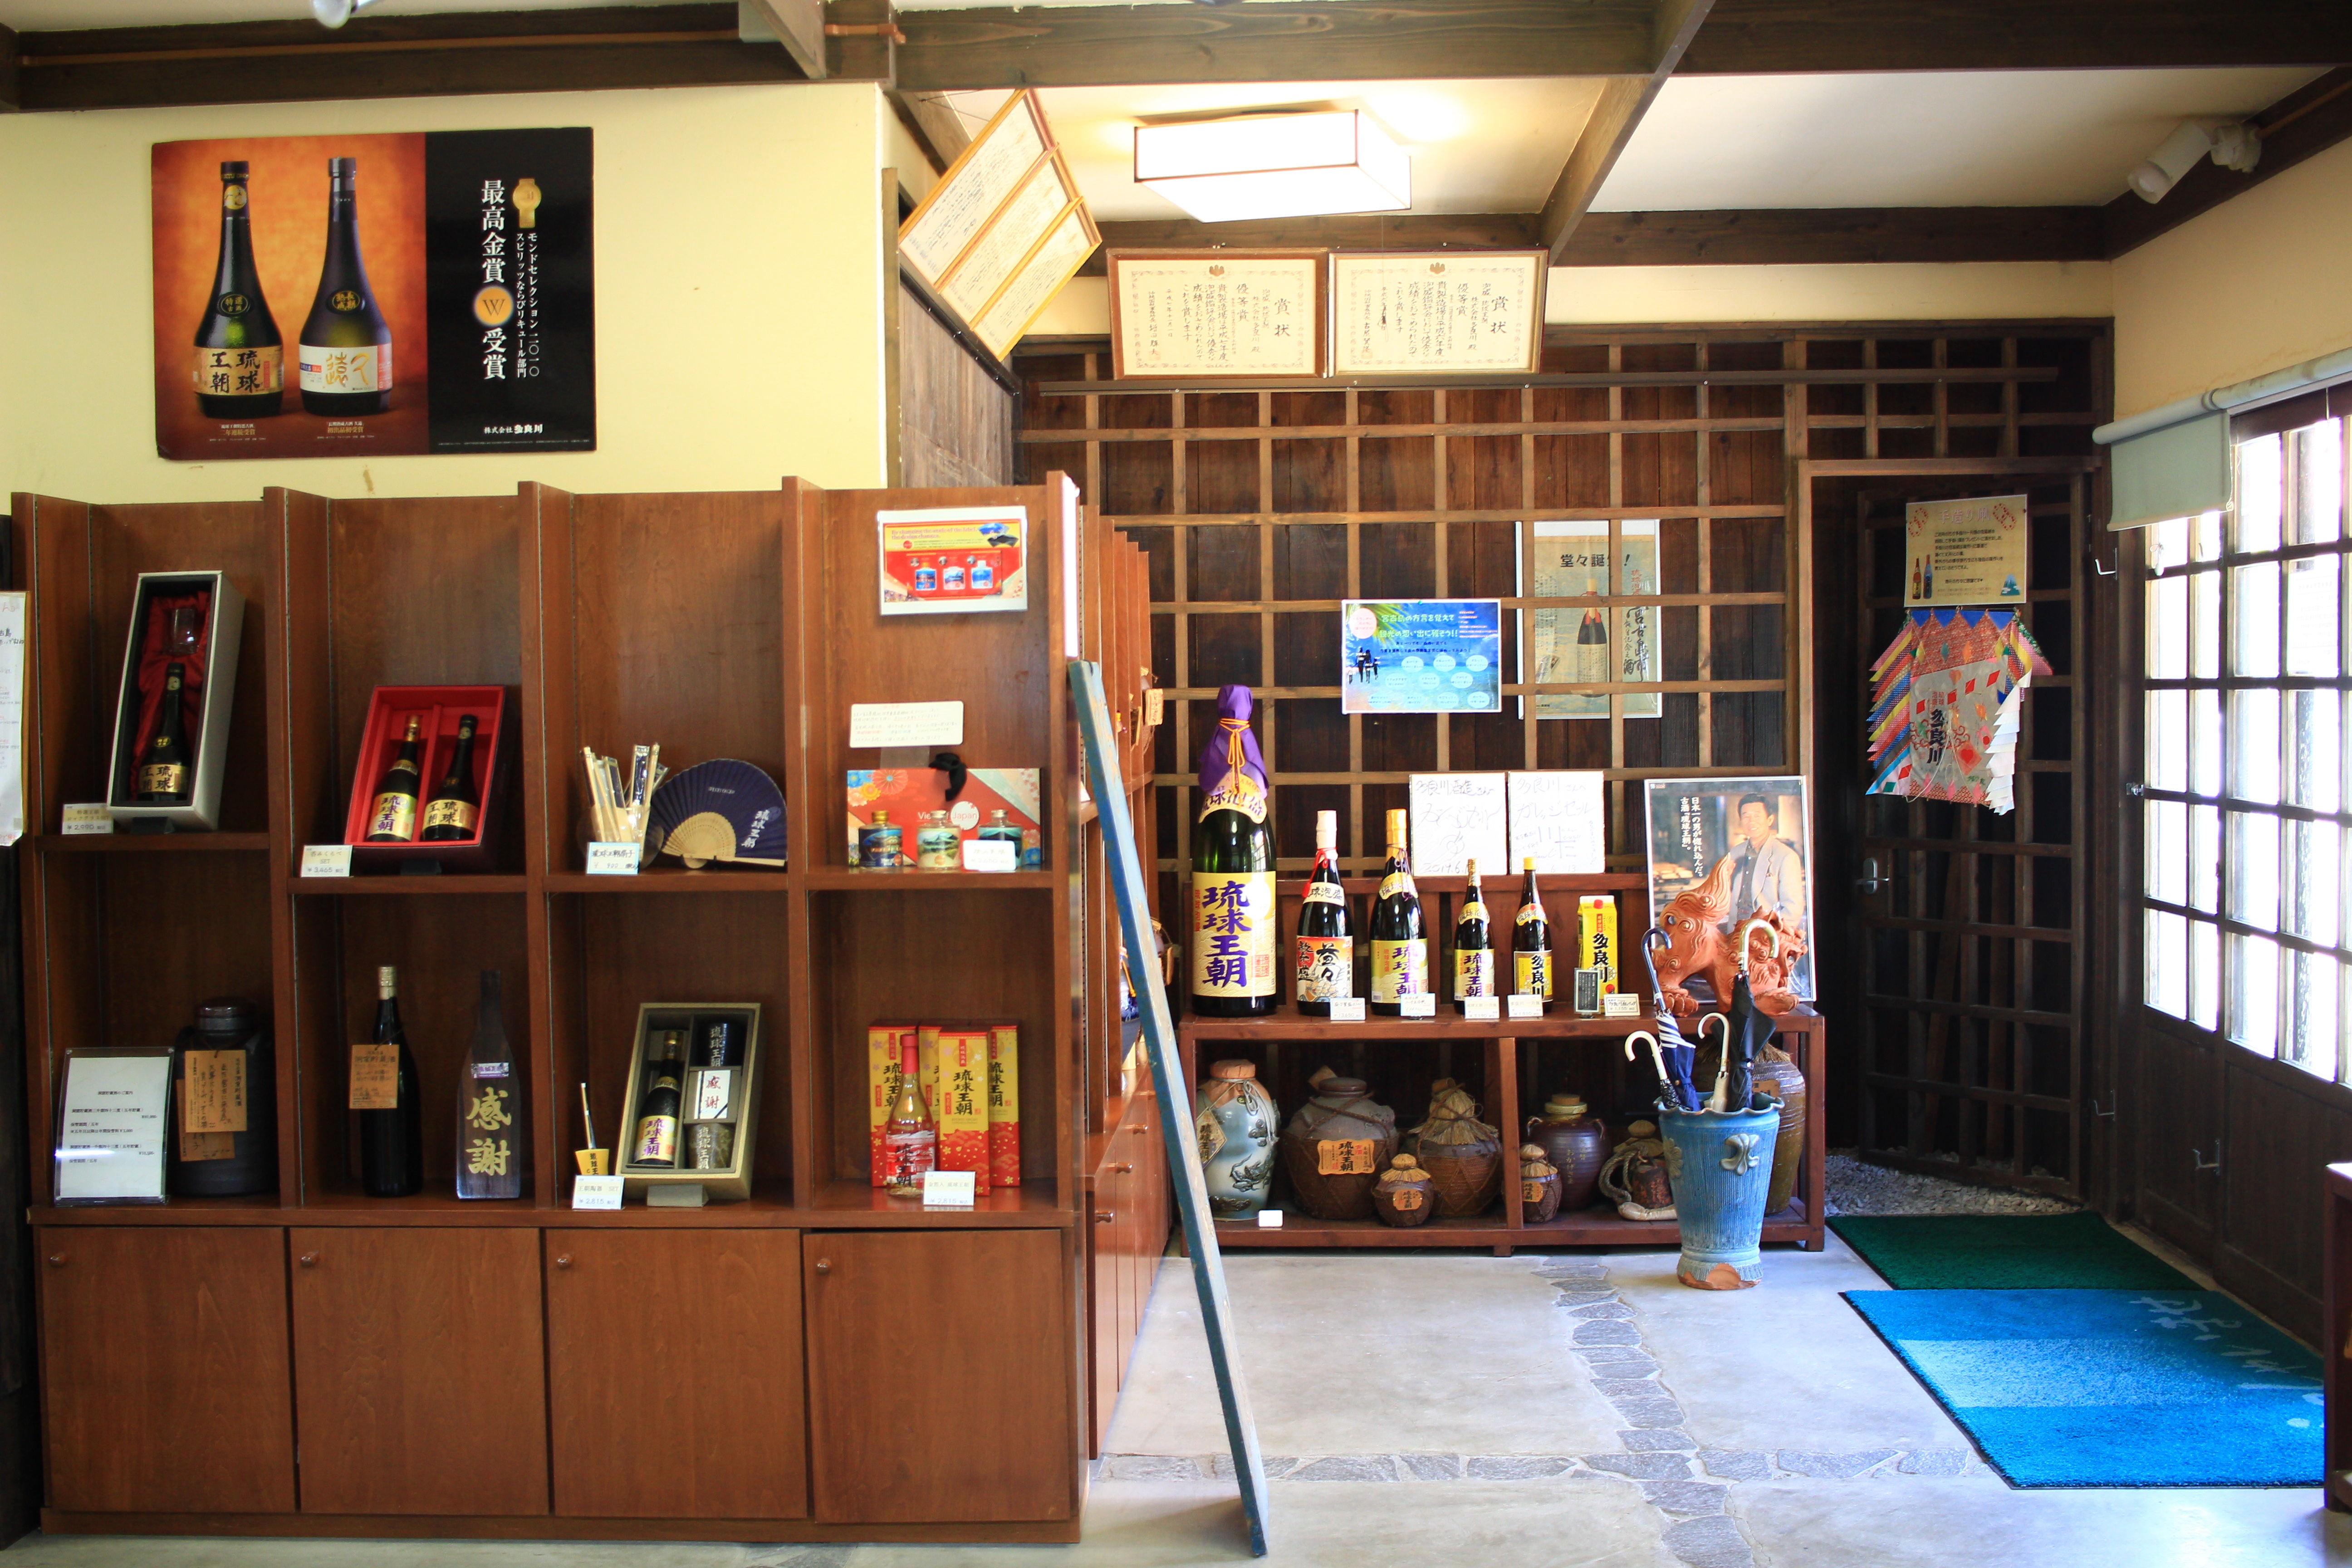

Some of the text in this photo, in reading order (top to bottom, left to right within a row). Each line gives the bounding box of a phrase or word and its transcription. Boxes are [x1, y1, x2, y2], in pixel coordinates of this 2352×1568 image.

[481, 180, 507, 380] 最高金賞 W 受賞
[1456, 282, 1470, 317] 優等賞
[1181, 284, 1193, 342] これを賞します
[1236, 283, 1250, 323] 優等賞
[1273, 298, 1291, 337] 賞状
[1394, 281, 1405, 334] これを賞します
[1489, 295, 1509, 334] 賞状
[210, 351, 233, 393] 王朝
[235, 350, 261, 393] 琉球
[1560, 554, 1630, 568] 堂々誕!
[1382, 614, 1455, 623] 宮古島の方言を覚えて
[1926, 708, 1945, 766] 多良川
[376, 795, 401, 832] 琉球王朝
[741, 809, 770, 849] 琉球王朝
[952, 811, 978, 821] Japan
[1680, 796, 1692, 851] 古酒「琉球王朝」。
[1691, 796, 1704, 877] 日本一の男が惚れ込んだ。
[1423, 861, 1468, 874] 2019.6.1
[1308, 886, 1343, 902] 球泡盛
[1201, 880, 1252, 989] 琉球王朝
[1392, 943, 1420, 999] 琉球王朝
[1463, 952, 1485, 997] 琉球王朝
[1531, 954, 1545, 1000] 多良川
[1592, 932, 1609, 983] 多良川
[710, 1026, 723, 1067] 琉球王朝
[705, 1075, 721, 1110] 感謝
[953, 1069, 975, 1116] 琉球王朝
[466, 1086, 512, 1176] 感謝
[644, 1117, 665, 1157] 琉球王朝
[696, 1126, 711, 1170] 琉球王朝
[1338, 1141, 1355, 1171] 琉球王朝
